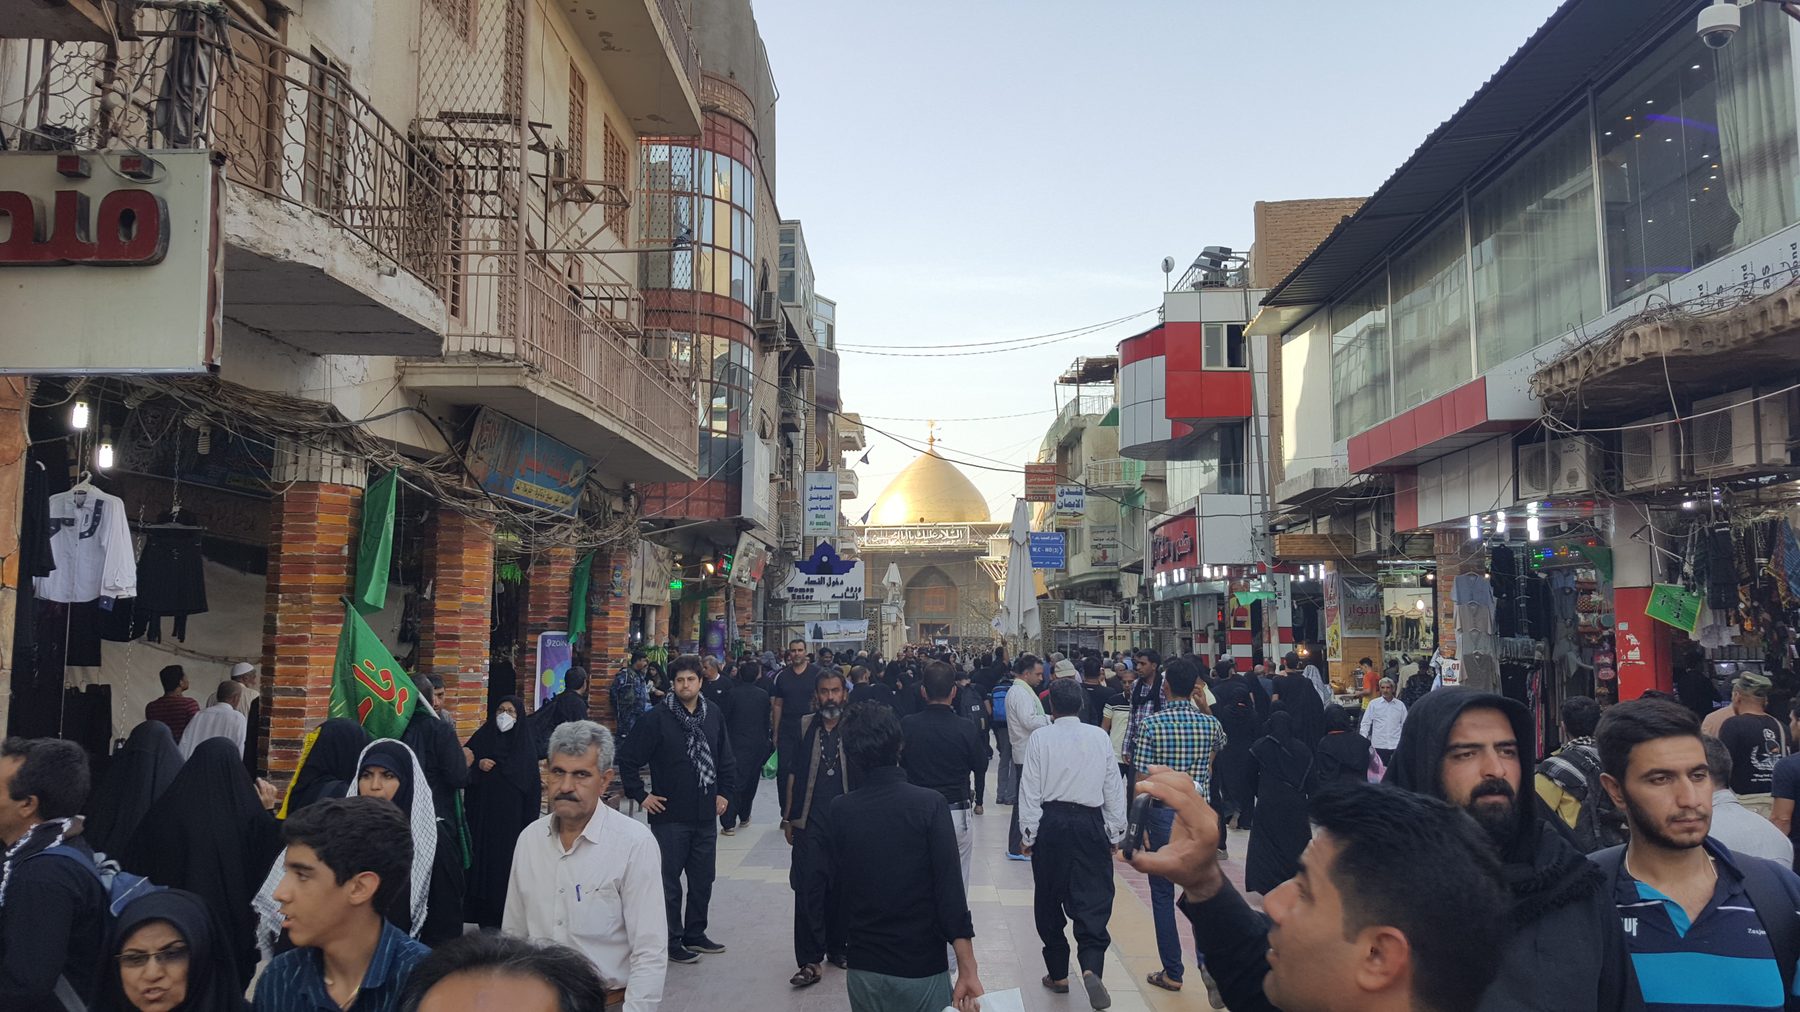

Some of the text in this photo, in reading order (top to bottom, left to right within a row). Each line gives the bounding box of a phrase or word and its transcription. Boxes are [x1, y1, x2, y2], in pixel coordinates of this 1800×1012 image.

[1058, 486, 1083, 498] فندق
[804, 576, 844, 587] دخول النساء
